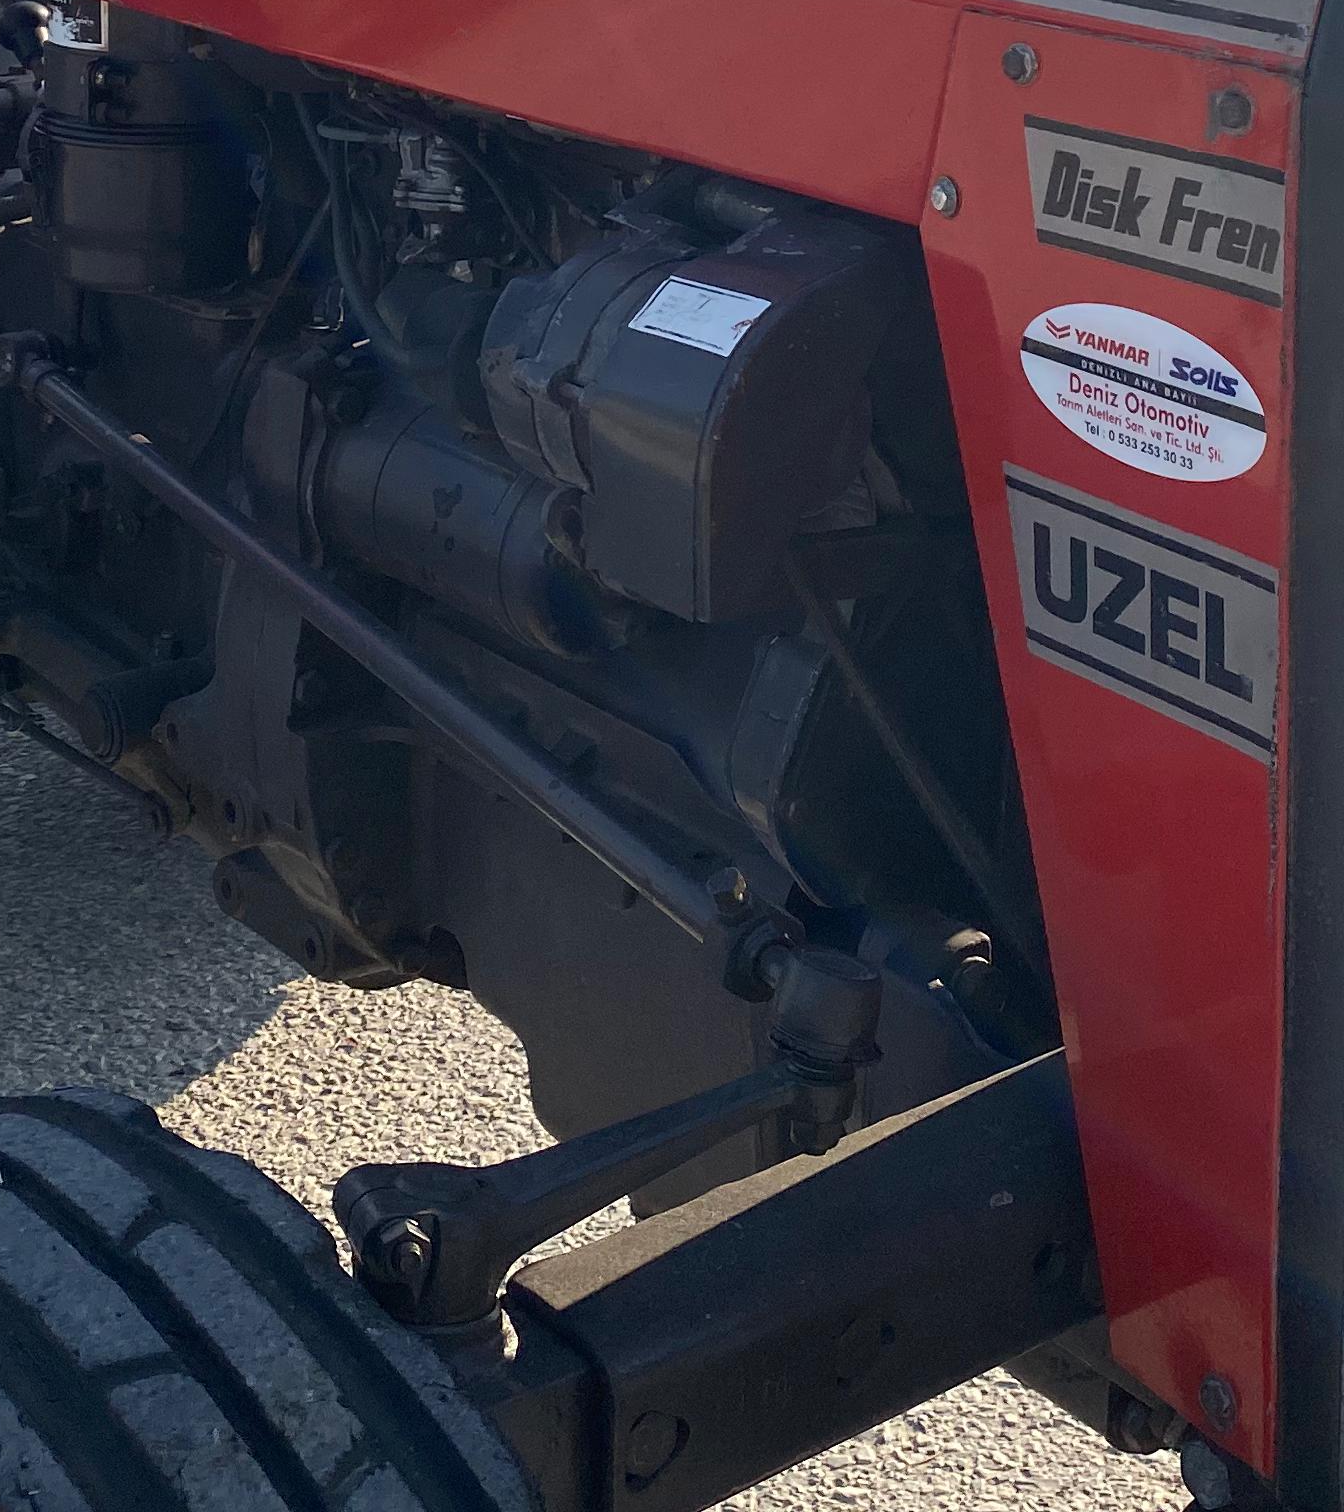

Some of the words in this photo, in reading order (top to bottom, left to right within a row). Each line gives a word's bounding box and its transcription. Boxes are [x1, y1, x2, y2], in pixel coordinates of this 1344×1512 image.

[1042, 148, 1151, 238] Disk
[1158, 176, 1282, 275] Fren
[1074, 328, 1150, 367] YANMAR
[1069, 372, 1119, 408] Deniz
[1124, 391, 1210, 439] Otomotiv
[1134, 378, 1158, 393] ANA
[1108, 429, 1116, 441] 0
[1118, 432, 1138, 450] 533
[1140, 441, 1161, 458] 253
[1163, 449, 1177, 464] 30
[1179, 455, 1194, 470] 33
[1150, 429, 1162, 441] ve
[1032, 521, 1254, 704] UZEL
